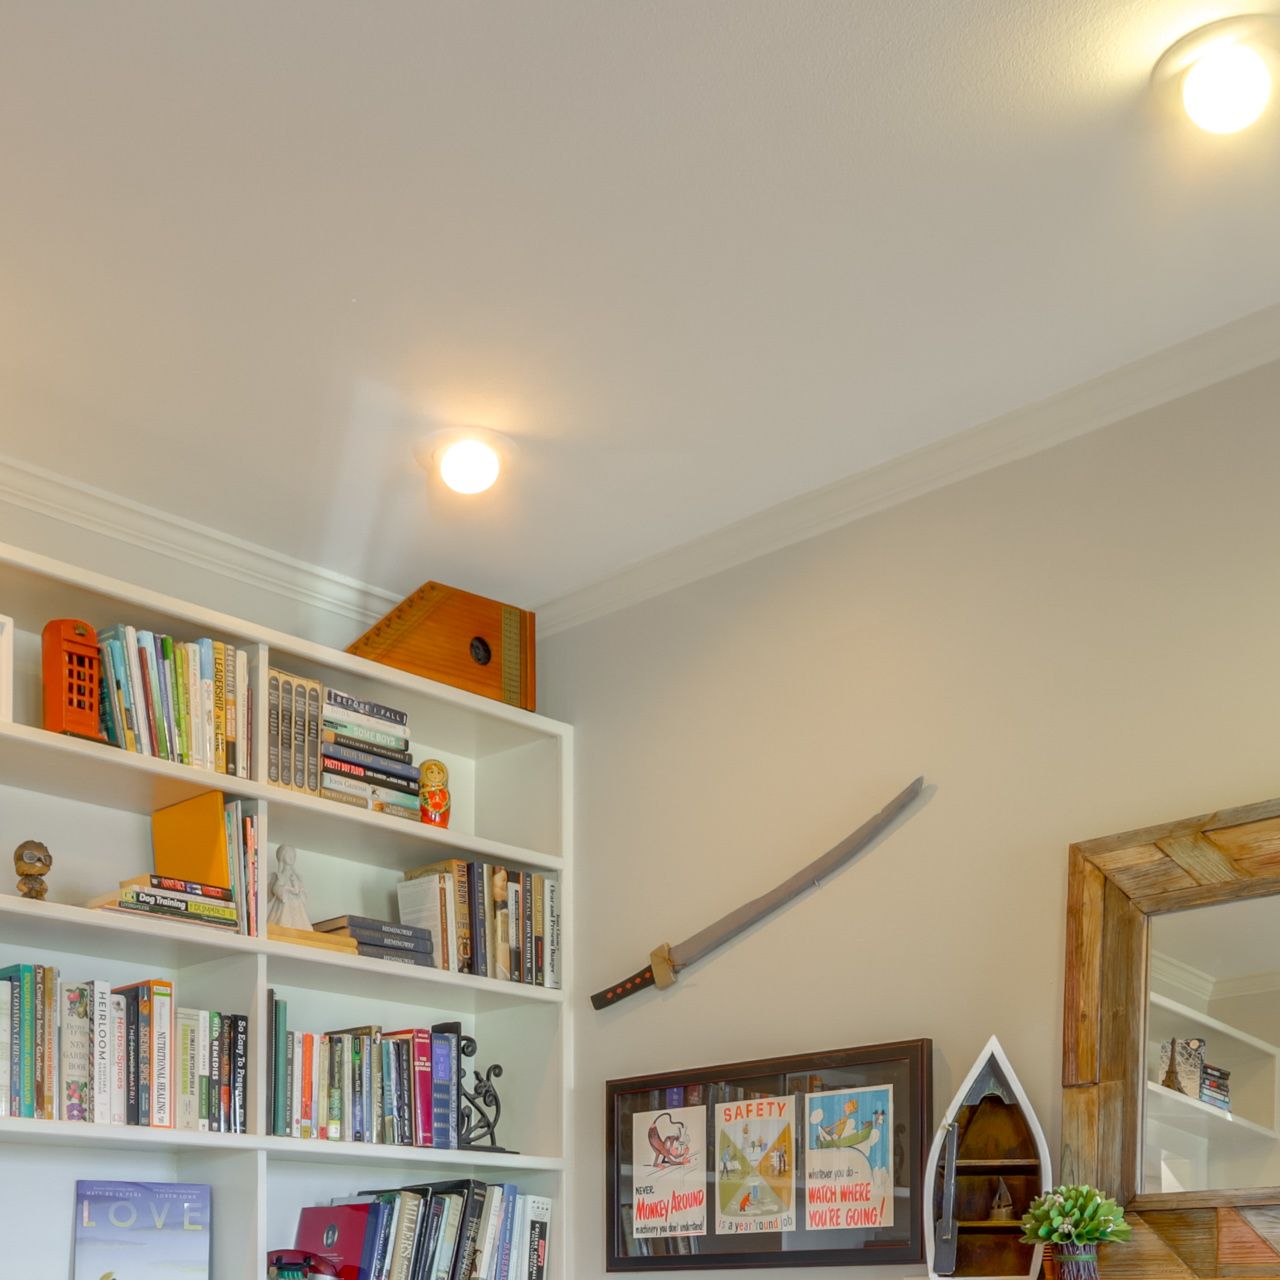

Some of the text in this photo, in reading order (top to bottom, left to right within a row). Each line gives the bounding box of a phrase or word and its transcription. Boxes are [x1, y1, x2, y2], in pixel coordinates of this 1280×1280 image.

[215, 657, 224, 711] LEADERSHIP
[336, 695, 370, 711] BEFORE
[381, 708, 401, 720] FALL
[354, 727, 396, 745] SOME BOYS
[324, 758, 365, 777] PRETTY BOY FLOYD
[457, 863, 467, 905] DAN BROWN
[139, 893, 156, 905] Dog
[156, 896, 187, 911] Training
[382, 925, 413, 937] HEMINGWAY
[384, 938, 415, 950] HEMINGWAY
[35, 968, 44, 1082] The Complete Indoor Gardener
[98, 991, 107, 1061] HEIRLOOM
[115, 1016, 124, 1090] Herbs Spices
[140, 1026, 149, 1058] SCIENCE
[212, 1017, 220, 1080] WILD REMEDIES
[140, 1063, 149, 1086] SPICE
[157, 1031, 167, 1114] NUTRITIONAL HEALING
[235, 1020, 246, 1105] So Easy To Preserve
[723, 1102, 787, 1123] SAFETY
[833, 1169, 844, 1181] you
[635, 1185, 655, 1196] NEVER
[808, 1182, 871, 1204] WATCH WHERE
[82, 1199, 203, 1231] LOVE
[635, 1189, 705, 1222] MONKEY AROUND
[808, 1196, 886, 1228] YOU'RE GOING!
[399, 1198, 419, 1258] MILLER'S
[635, 1221, 659, 1235] machinery
[659, 1224, 668, 1233] you
[728, 1223, 733, 1232] a
[734, 1221, 753, 1232] year
[753, 1218, 779, 1232] 'round
[780, 1215, 793, 1231] job
